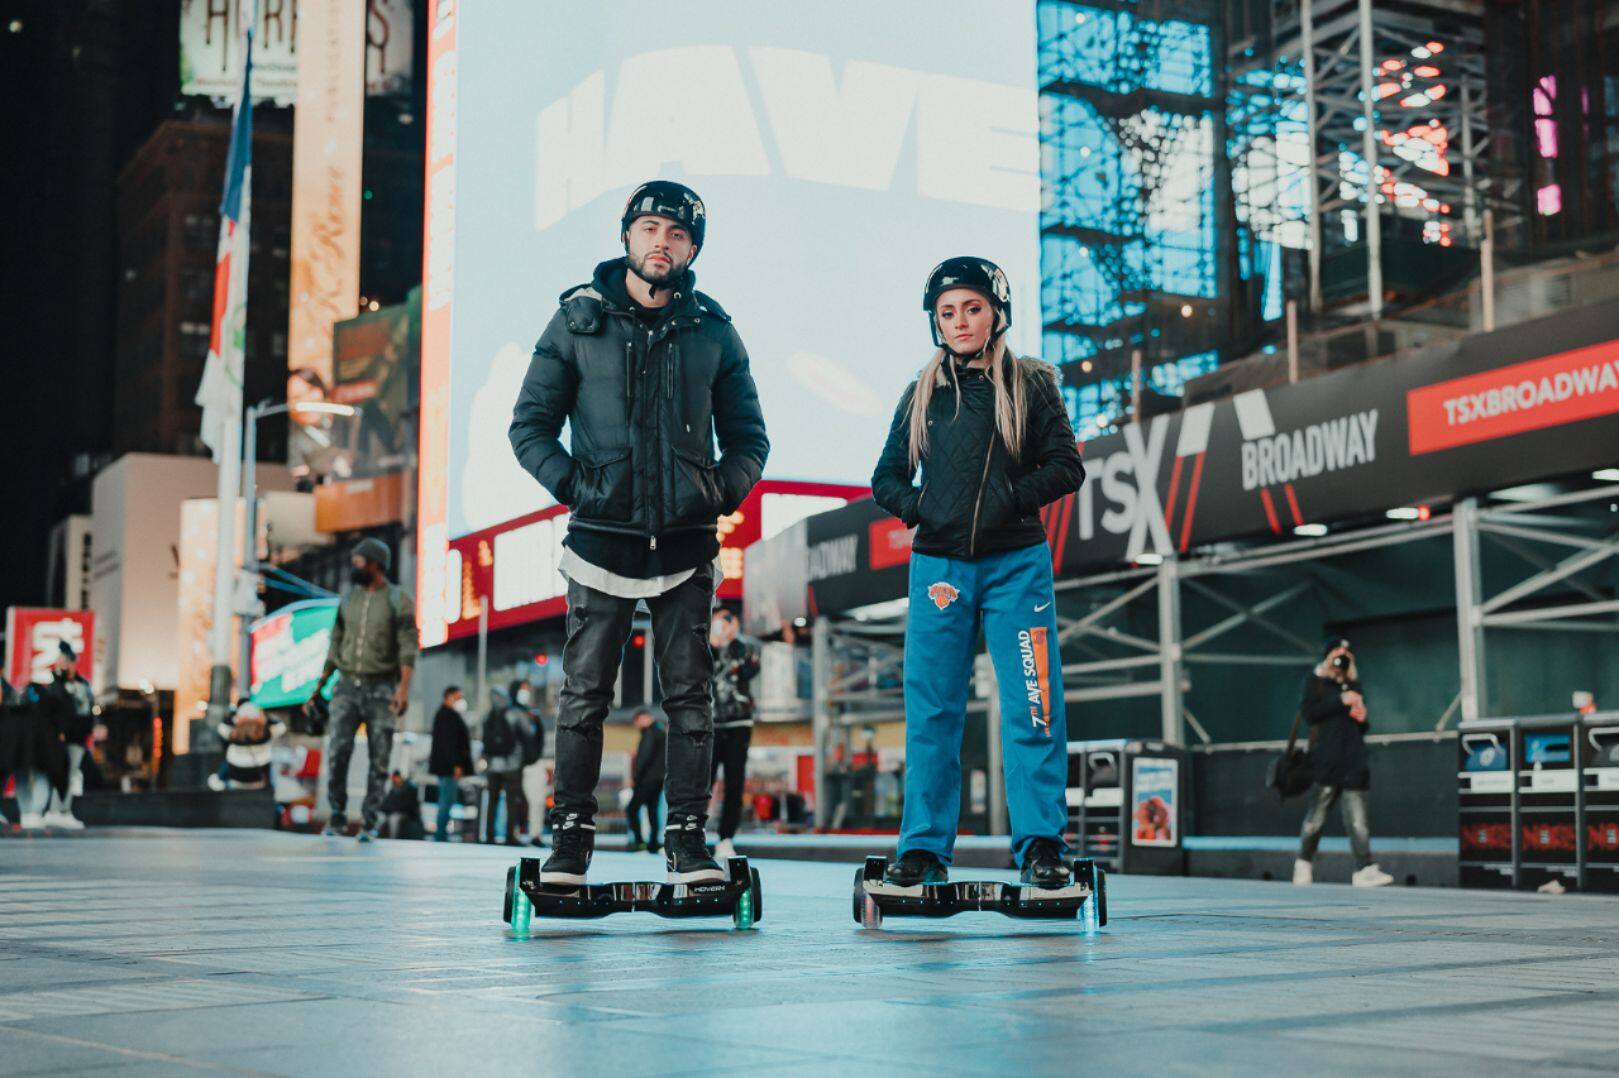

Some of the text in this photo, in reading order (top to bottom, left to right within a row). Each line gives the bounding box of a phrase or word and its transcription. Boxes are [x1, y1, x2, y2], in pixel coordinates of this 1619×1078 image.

[1076, 408, 1378, 563] TSX BROADWAY
[1018, 630, 1037, 677] SQUAD
[1026, 680, 1042, 705] AVE
